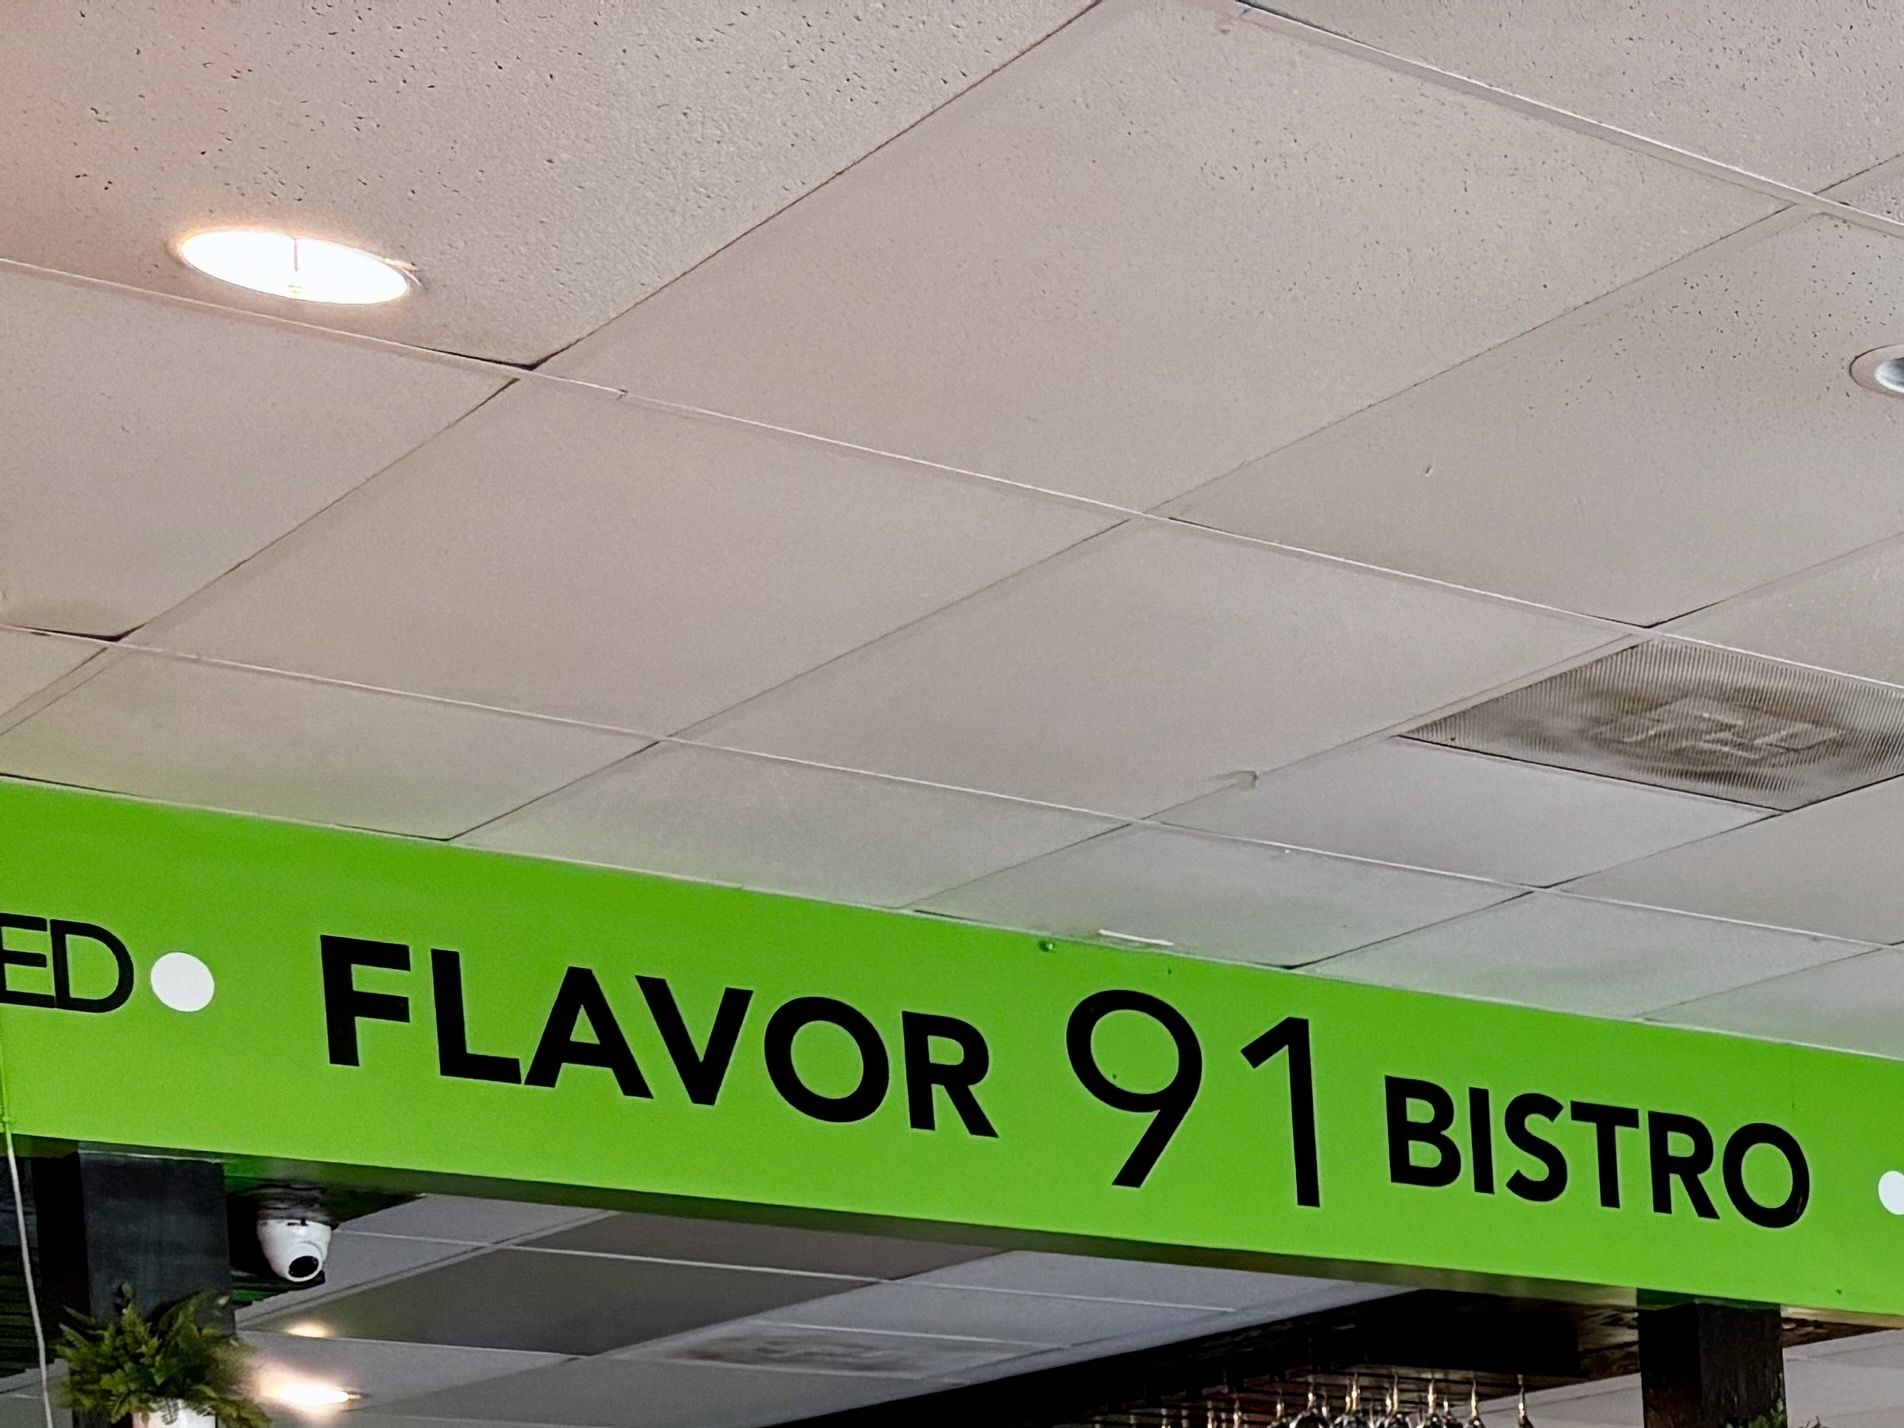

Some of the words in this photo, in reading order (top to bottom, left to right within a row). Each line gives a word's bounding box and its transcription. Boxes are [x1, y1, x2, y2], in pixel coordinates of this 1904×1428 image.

[319, 934, 999, 1138] FLAVOR
[1066, 989, 1321, 1208] 91
[1384, 1075, 1811, 1229] BISTRO
